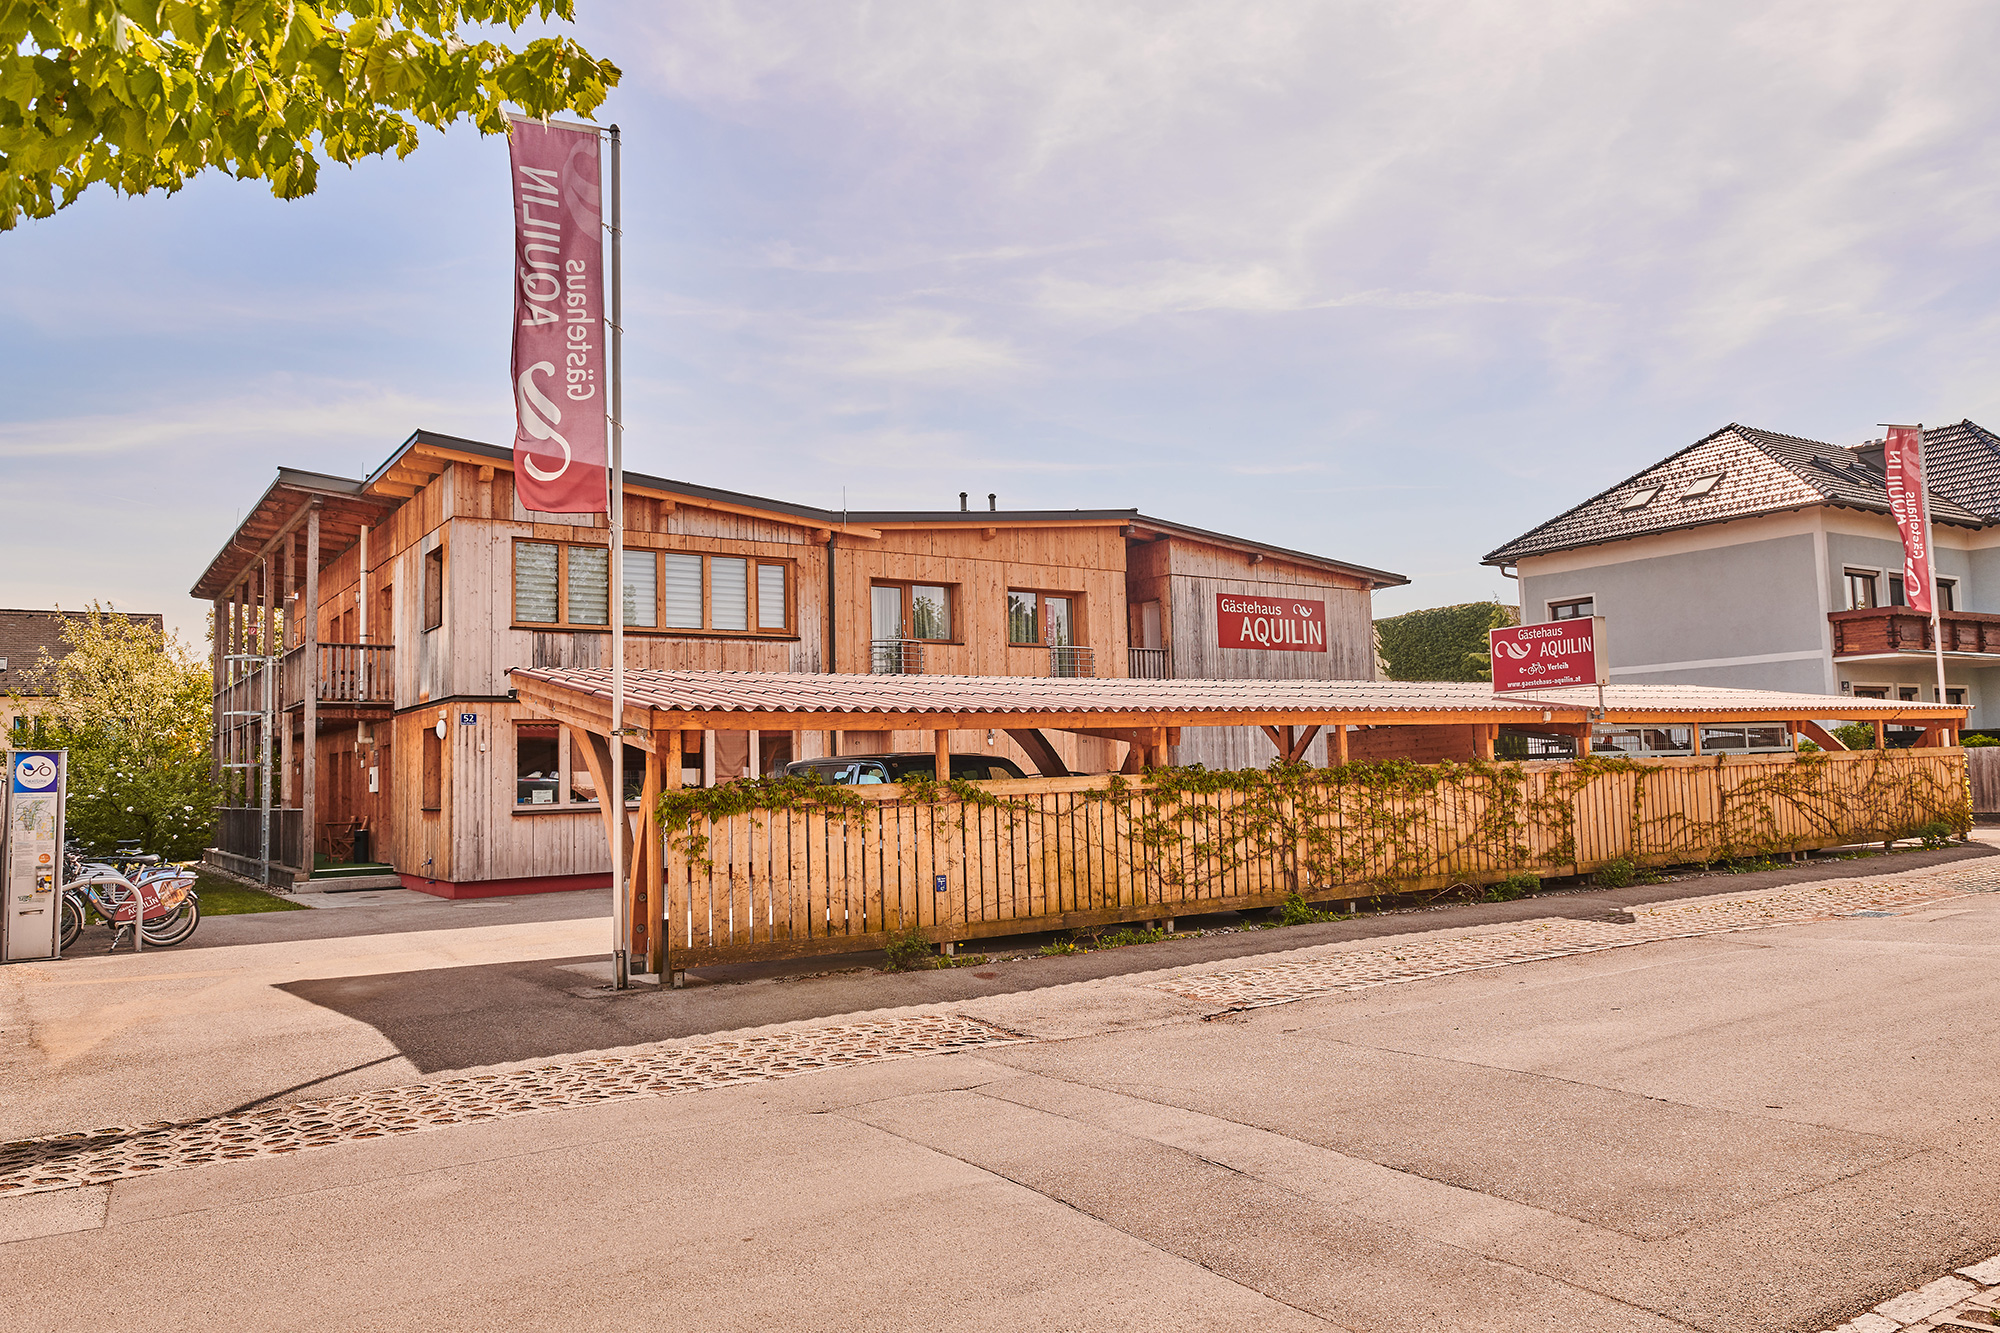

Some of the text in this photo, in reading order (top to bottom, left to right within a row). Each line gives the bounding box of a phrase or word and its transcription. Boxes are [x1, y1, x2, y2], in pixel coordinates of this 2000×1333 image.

[1221, 598, 1282, 616] Gästehaus
[1240, 616, 1322, 647] AQUILIN
[1517, 627, 1563, 641] Gästehaus
[1540, 636, 1592, 658] AQUILIN
[1547, 662, 1569, 671] Verleih
[1507, 675, 1581, 689] www.gaestehaus-aquilin.at
[463, 714, 474, 722] 52
